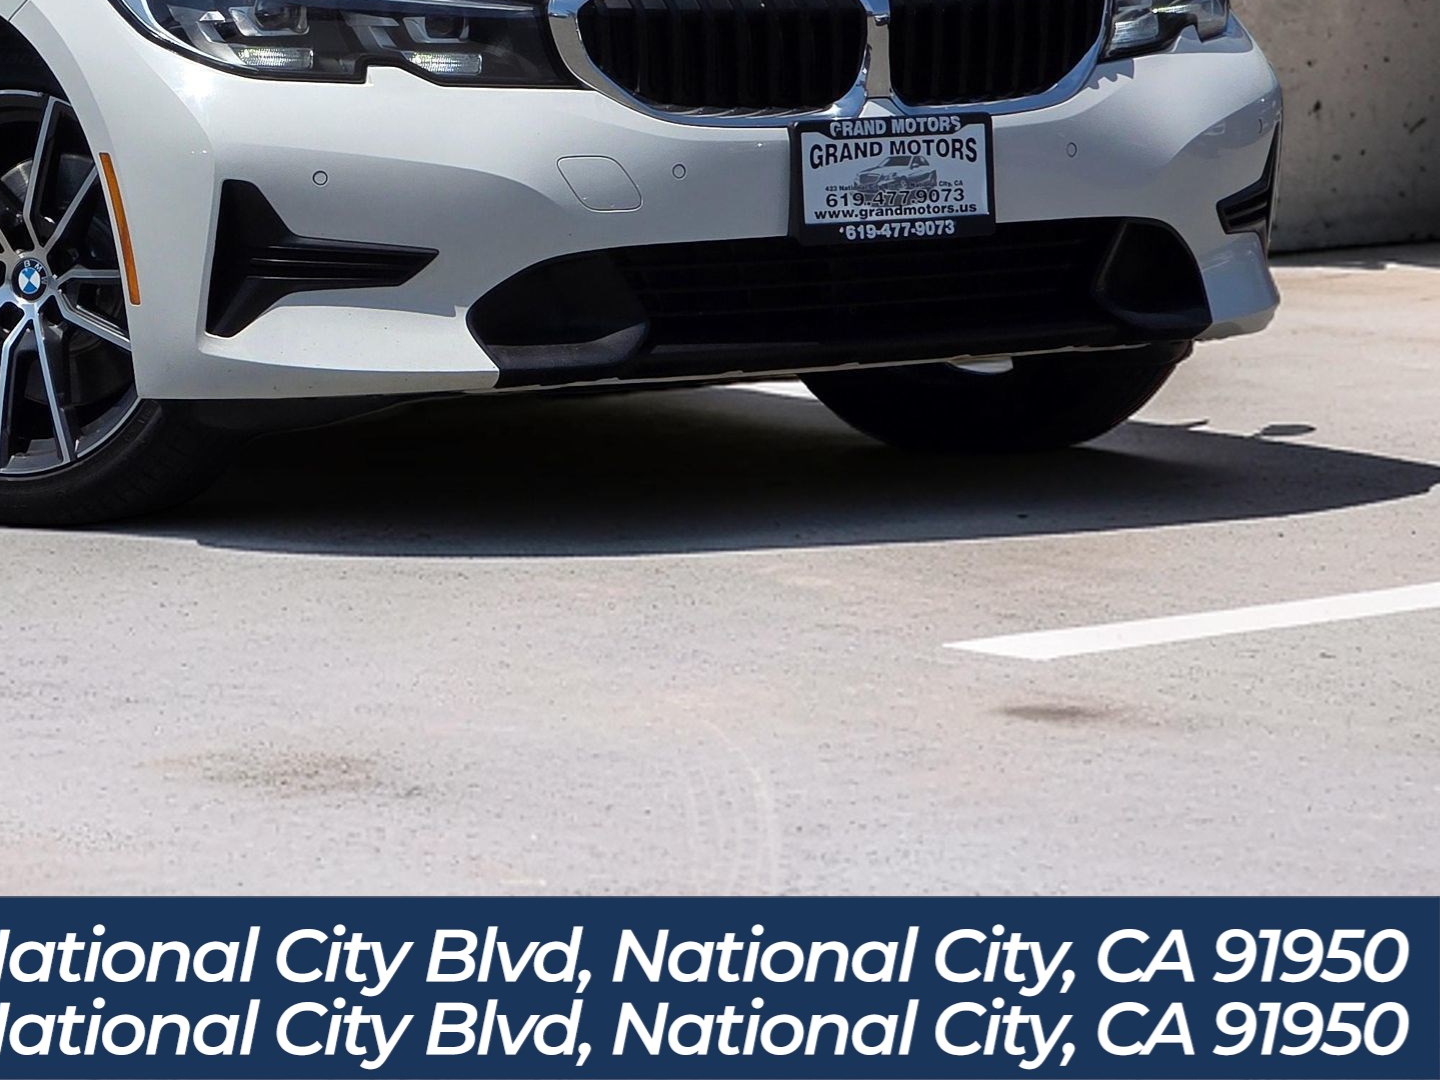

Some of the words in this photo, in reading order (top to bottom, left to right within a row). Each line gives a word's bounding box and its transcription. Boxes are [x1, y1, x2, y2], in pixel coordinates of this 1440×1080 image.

[830, 120, 887, 137] GRAND
[891, 115, 961, 134] MOTORS
[809, 141, 883, 170] GRAND
[889, 137, 978, 163] MOTORS
[814, 203, 978, 220] www.grandmotors.us
